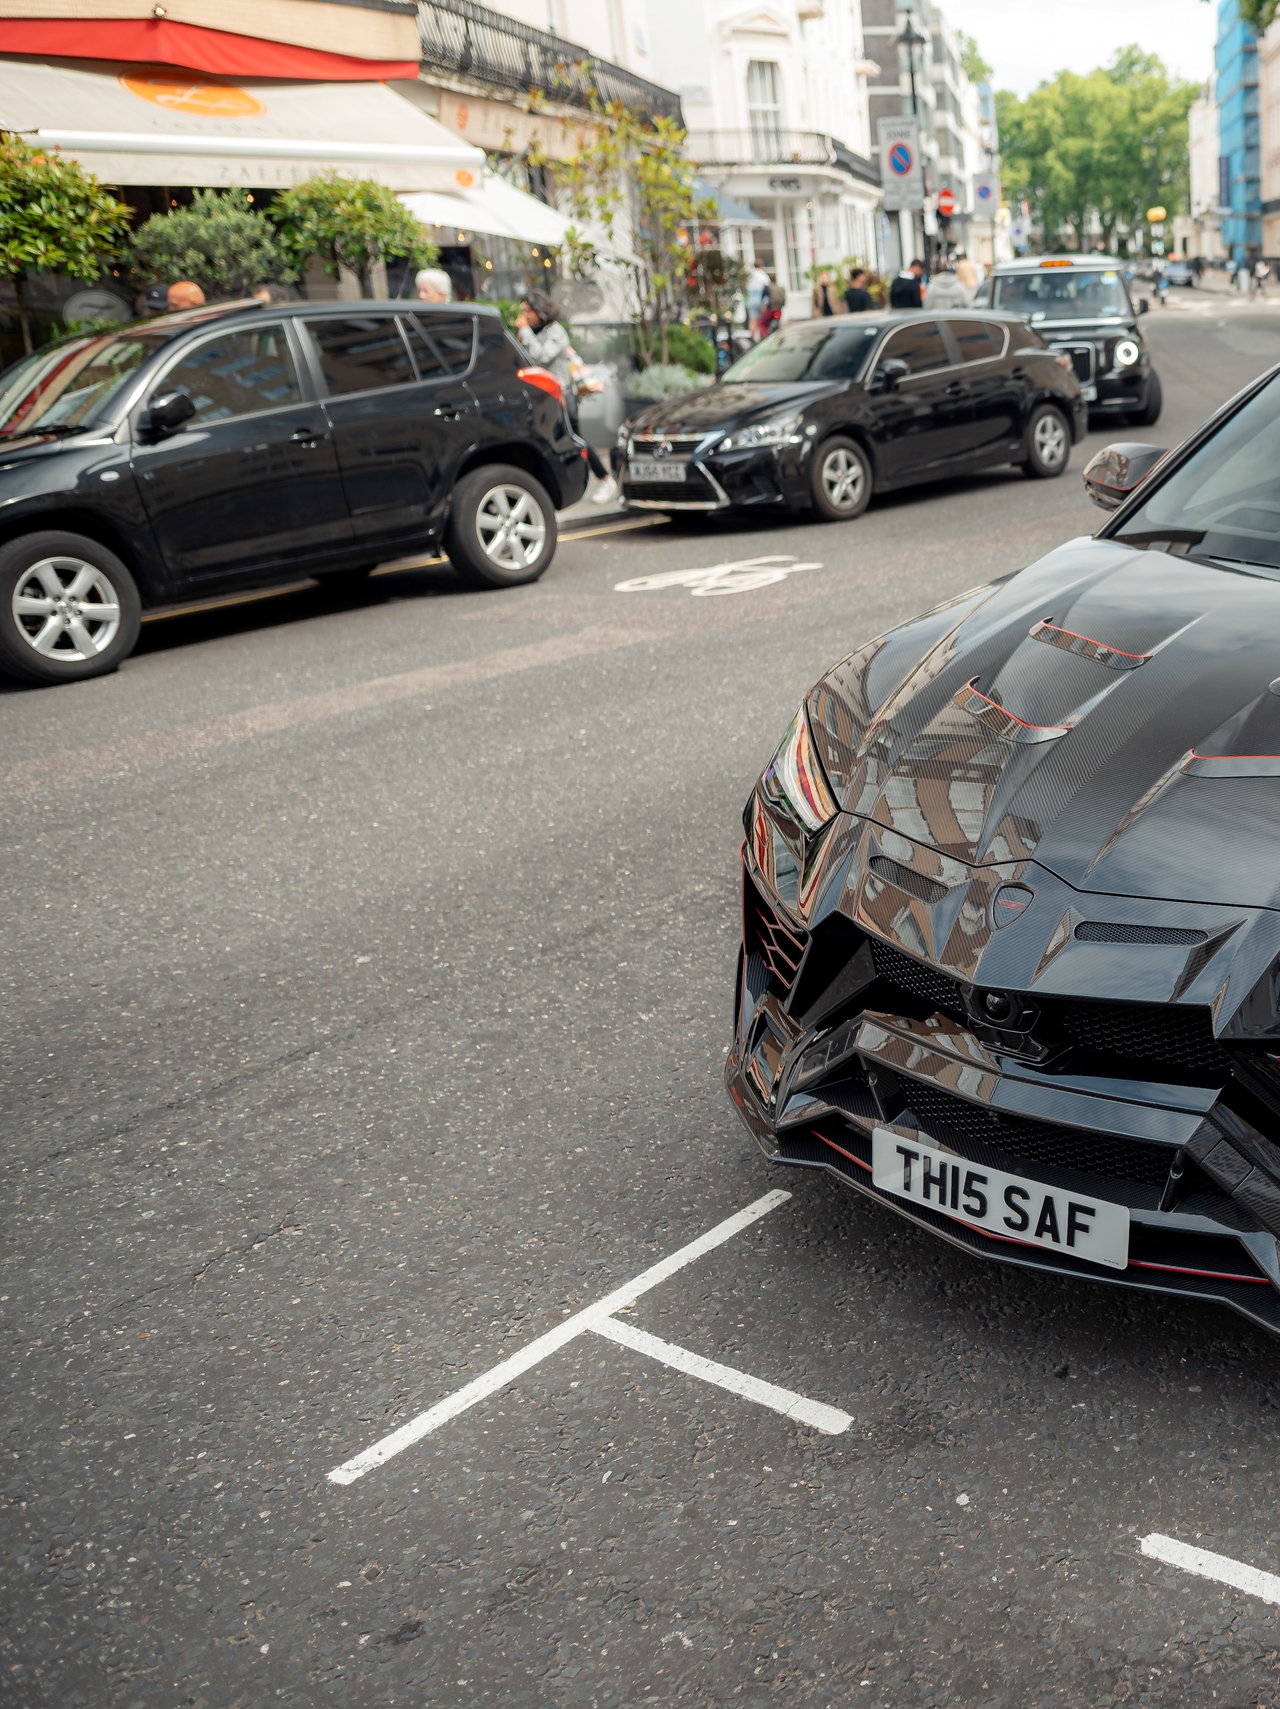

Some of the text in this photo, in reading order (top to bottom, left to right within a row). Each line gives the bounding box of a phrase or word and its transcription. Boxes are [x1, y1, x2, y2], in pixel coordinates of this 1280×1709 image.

[219, 164, 380, 182] ZAFFERNO
[896, 1144, 1096, 1248] TH15 SAF
